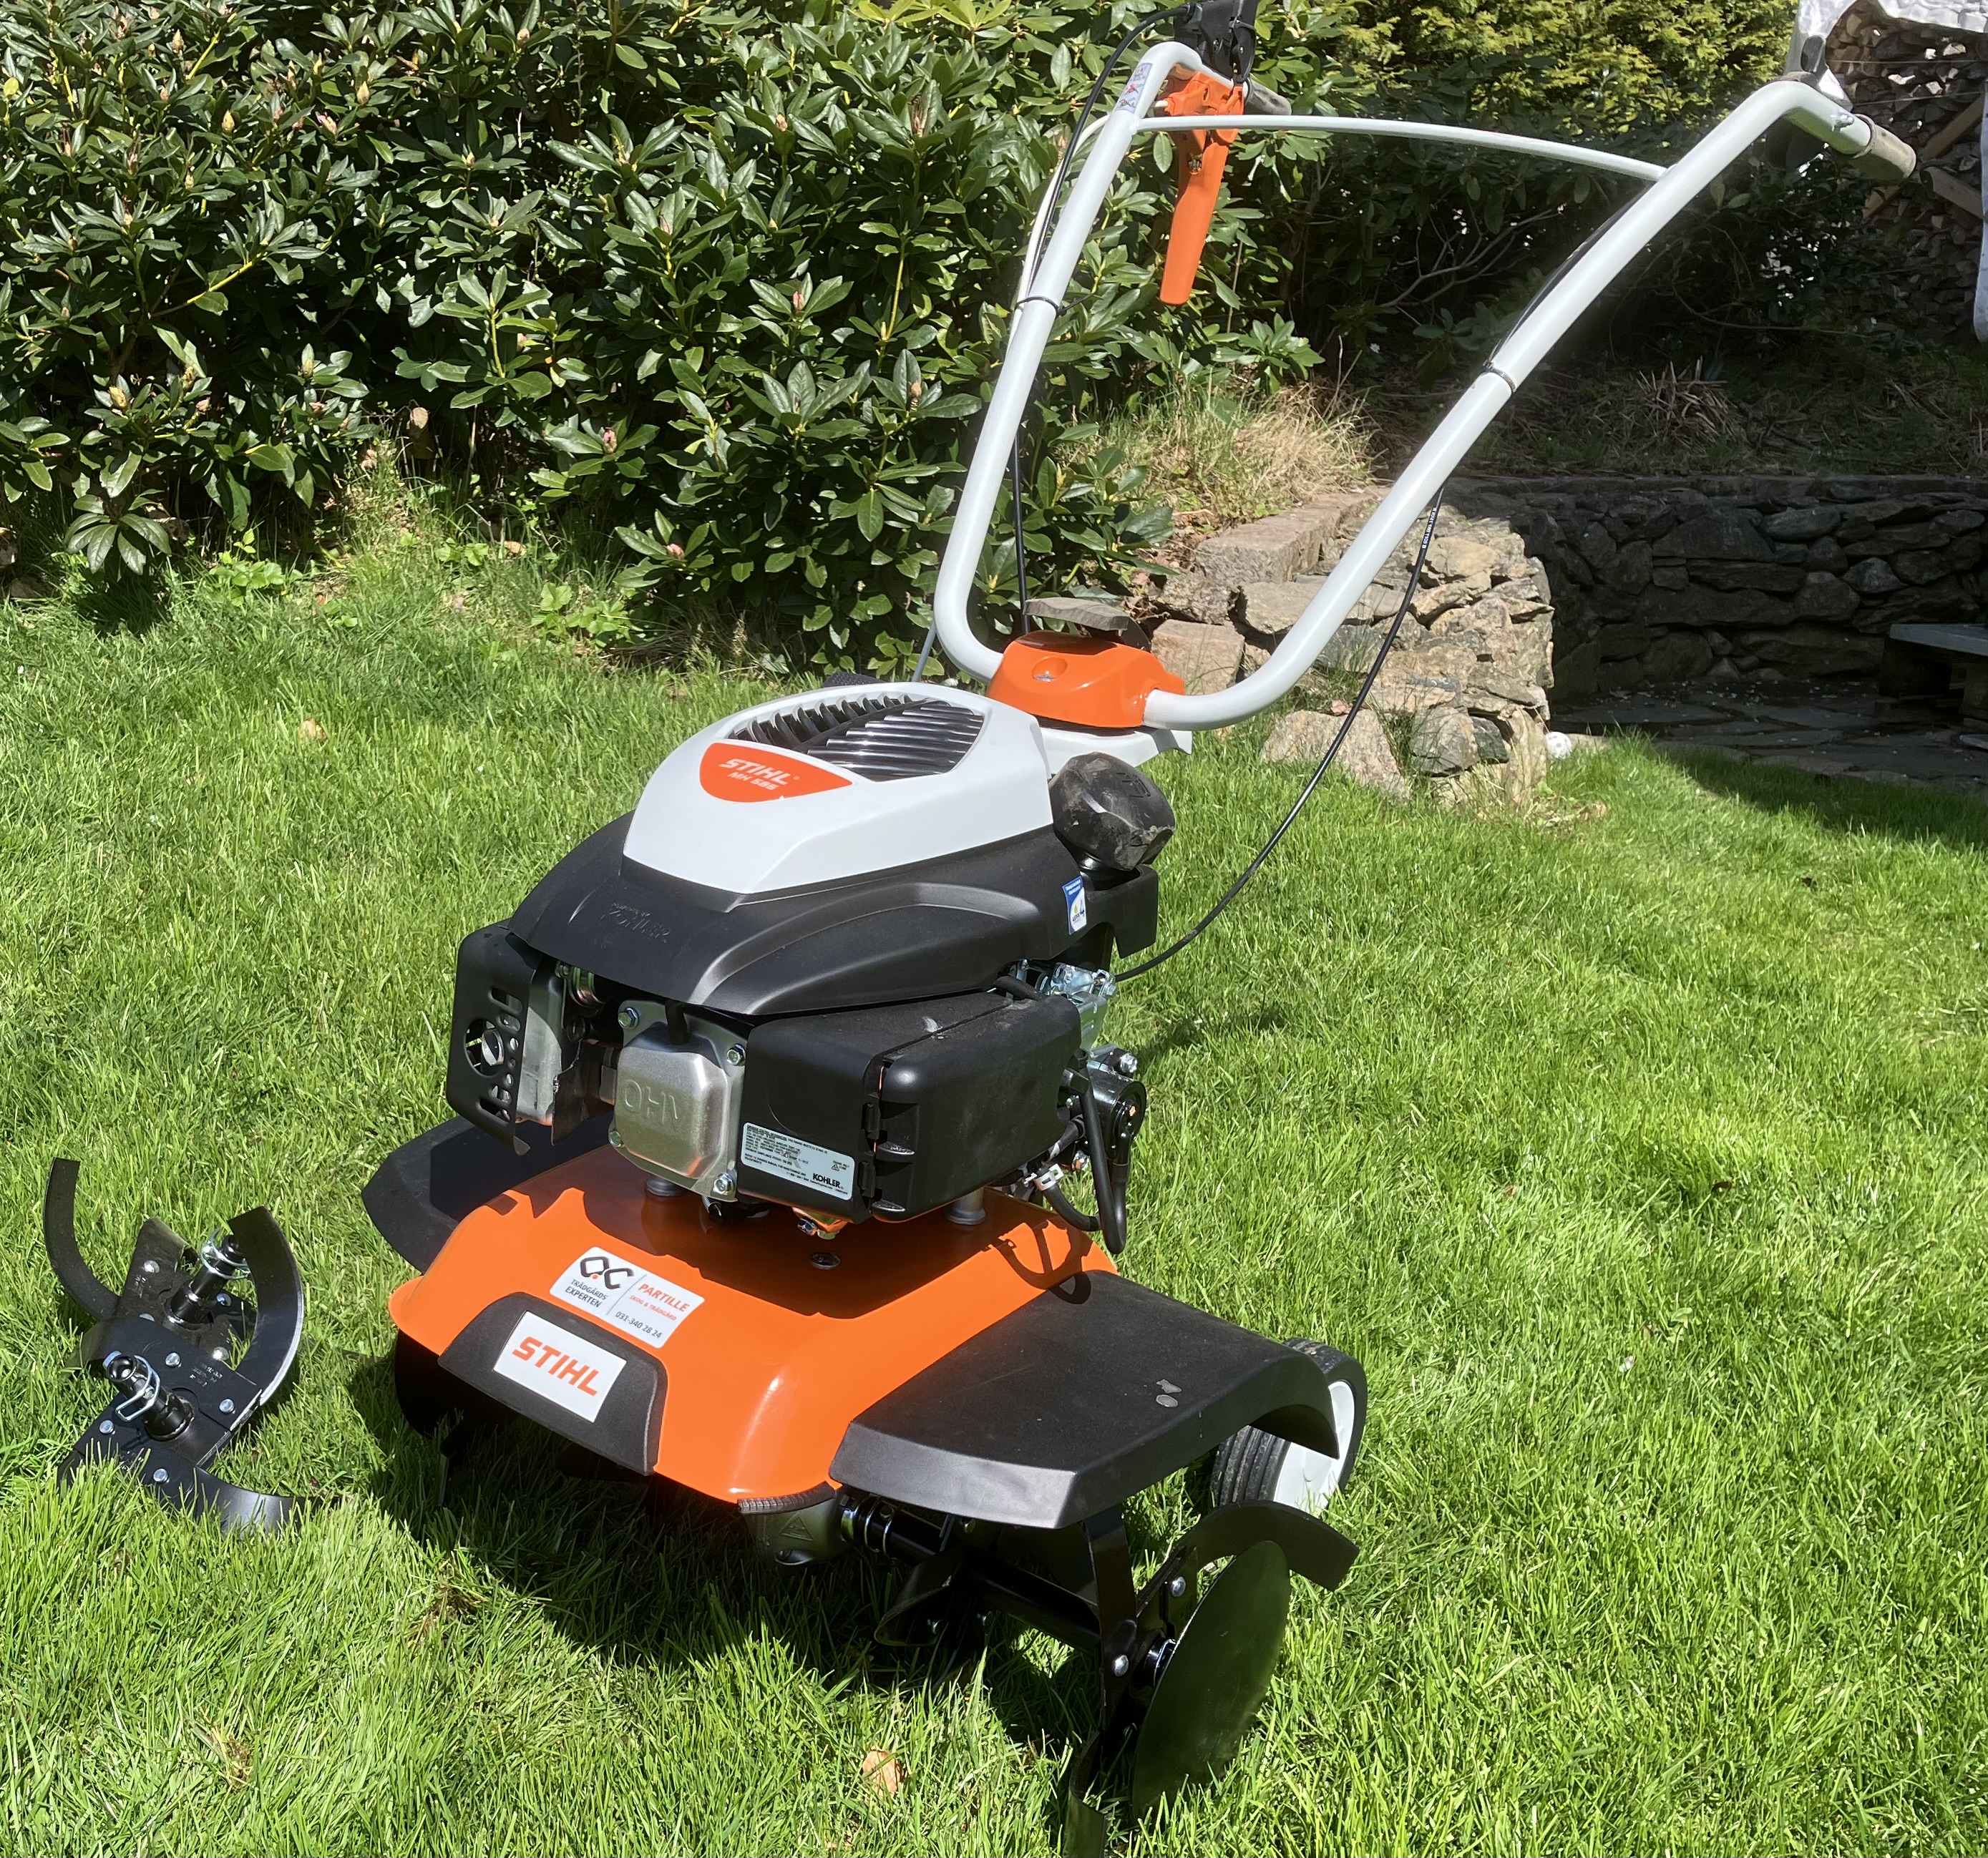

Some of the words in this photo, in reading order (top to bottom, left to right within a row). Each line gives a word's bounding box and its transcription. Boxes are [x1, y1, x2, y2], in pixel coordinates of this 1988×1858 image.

[718, 758, 791, 785] STIHL
[727, 772, 753, 781] MH
[812, 1173, 841, 1188] KOHLER
[565, 1286, 603, 1308] EXPERTEN
[570, 1278, 608, 1300] TRÄDGÅRDS
[629, 1295, 643, 1305] SKOG
[638, 1284, 690, 1312] PARTILLE
[615, 1311, 643, 1329] 031-340
[641, 1324, 653, 1334] 28
[651, 1329, 663, 1339] 24
[512, 1336, 600, 1397] STIHL
